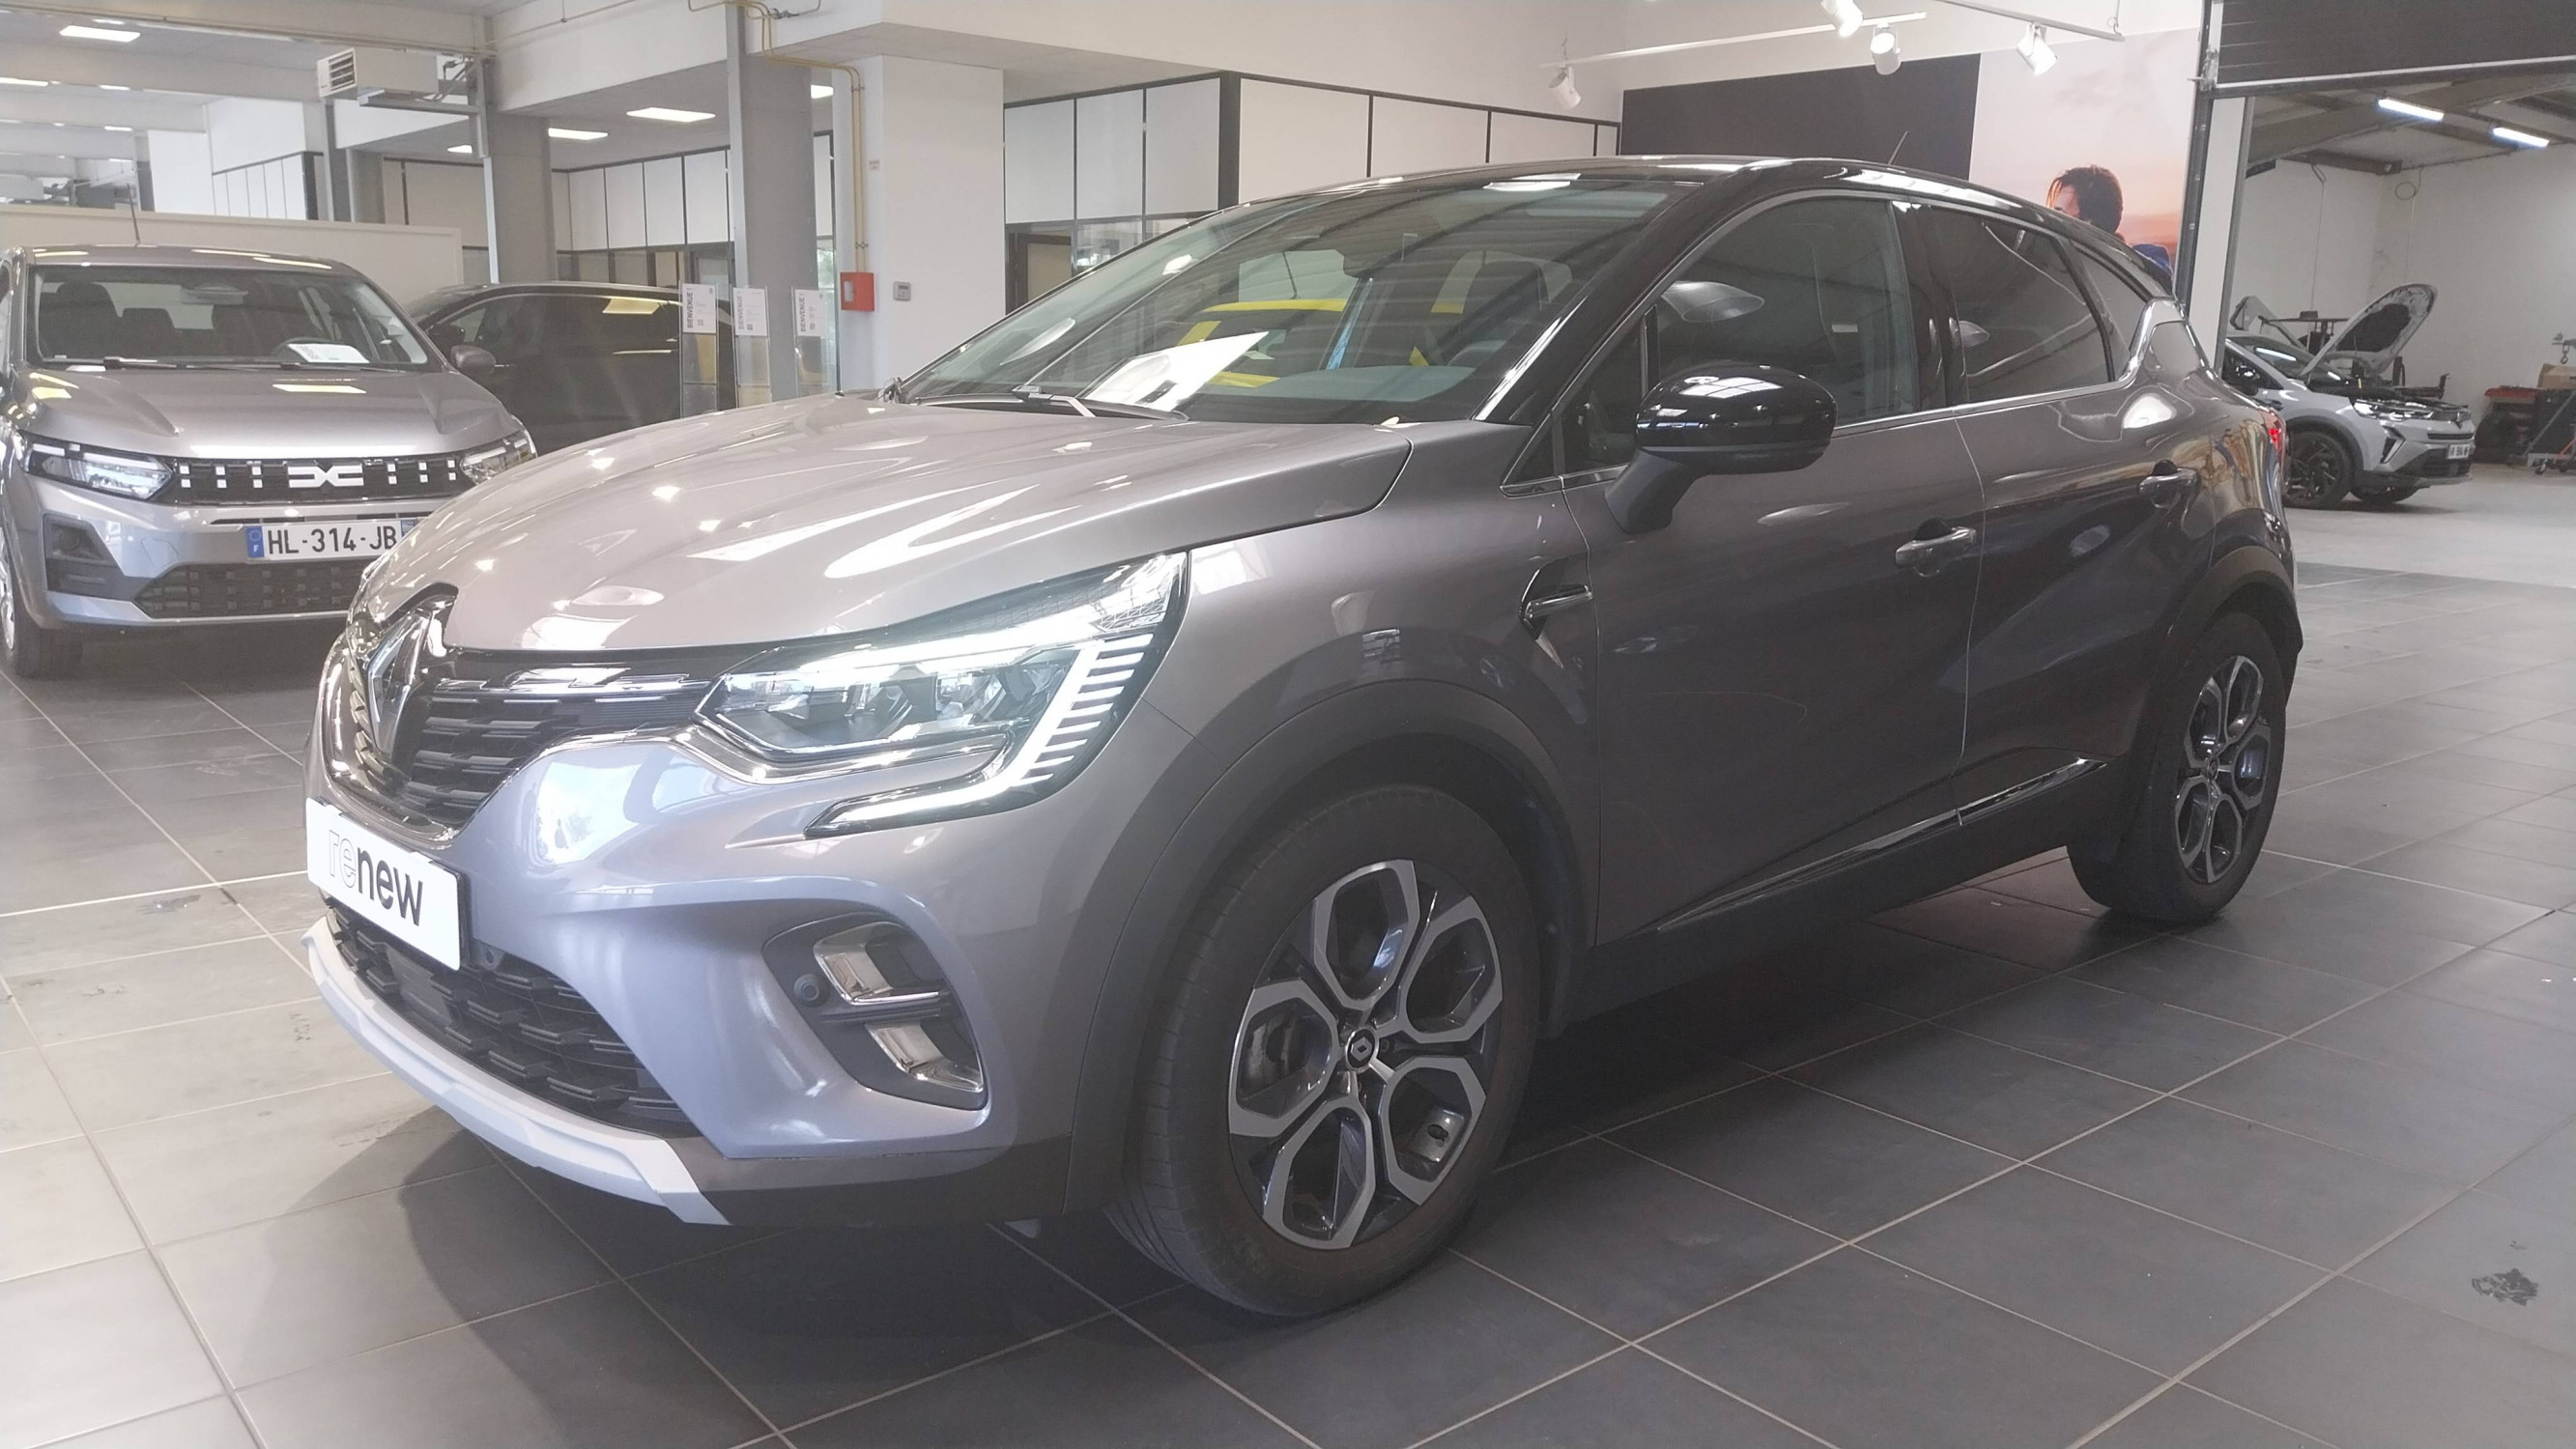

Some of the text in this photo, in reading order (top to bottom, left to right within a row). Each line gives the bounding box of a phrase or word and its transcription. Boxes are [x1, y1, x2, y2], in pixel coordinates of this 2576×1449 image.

[735, 296, 744, 329] BIENVENUE
[798, 298, 807, 332] BIENVENUE
[252, 544, 259, 553] F
[268, 526, 398, 554] HL-314-JB
[329, 829, 423, 927] renew
